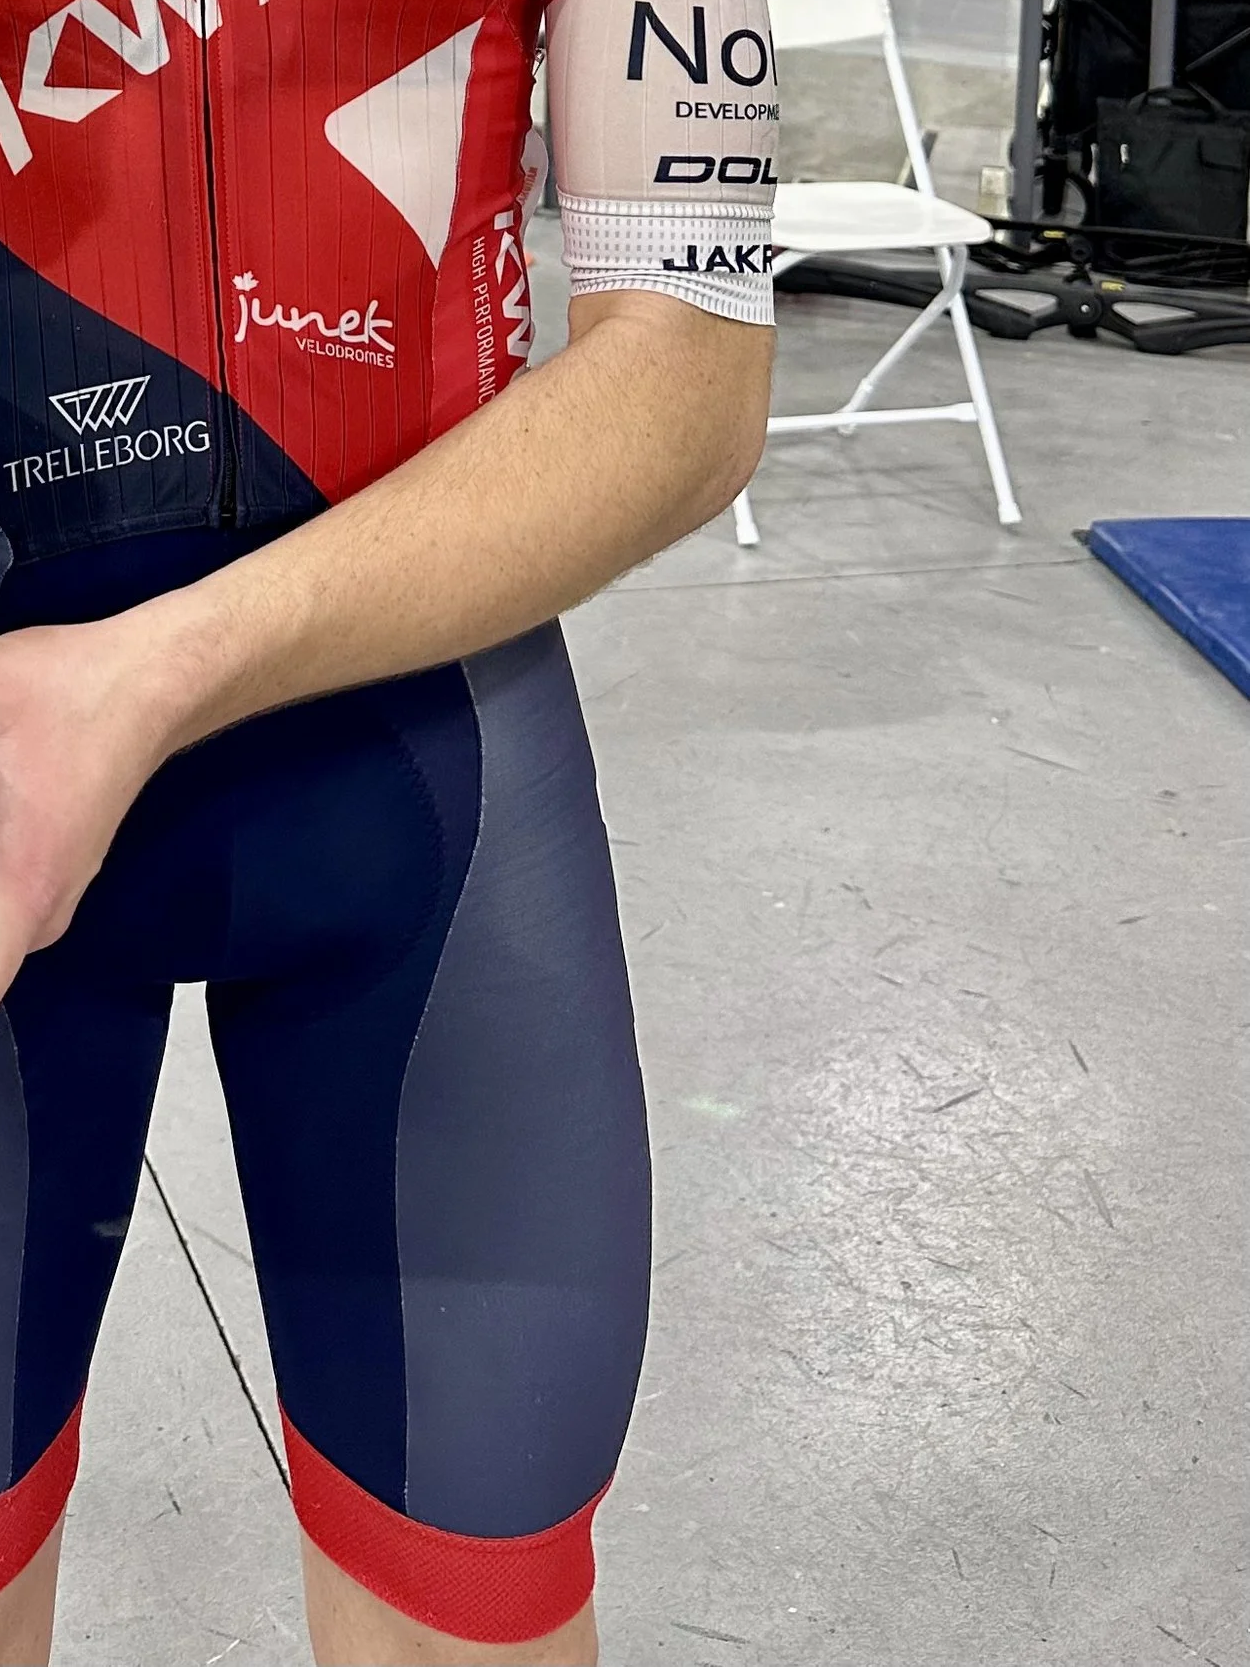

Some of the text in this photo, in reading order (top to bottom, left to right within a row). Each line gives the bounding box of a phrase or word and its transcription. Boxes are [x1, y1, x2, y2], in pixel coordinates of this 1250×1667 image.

[627, 1, 778, 86] No
[653, 156, 778, 184] DOL
[232, 270, 396, 353] junek
[472, 236, 496, 405] HIGH PERFORMANC
[296, 336, 395, 369] VELODROMES
[3, 420, 211, 493] TRELLEBORG
